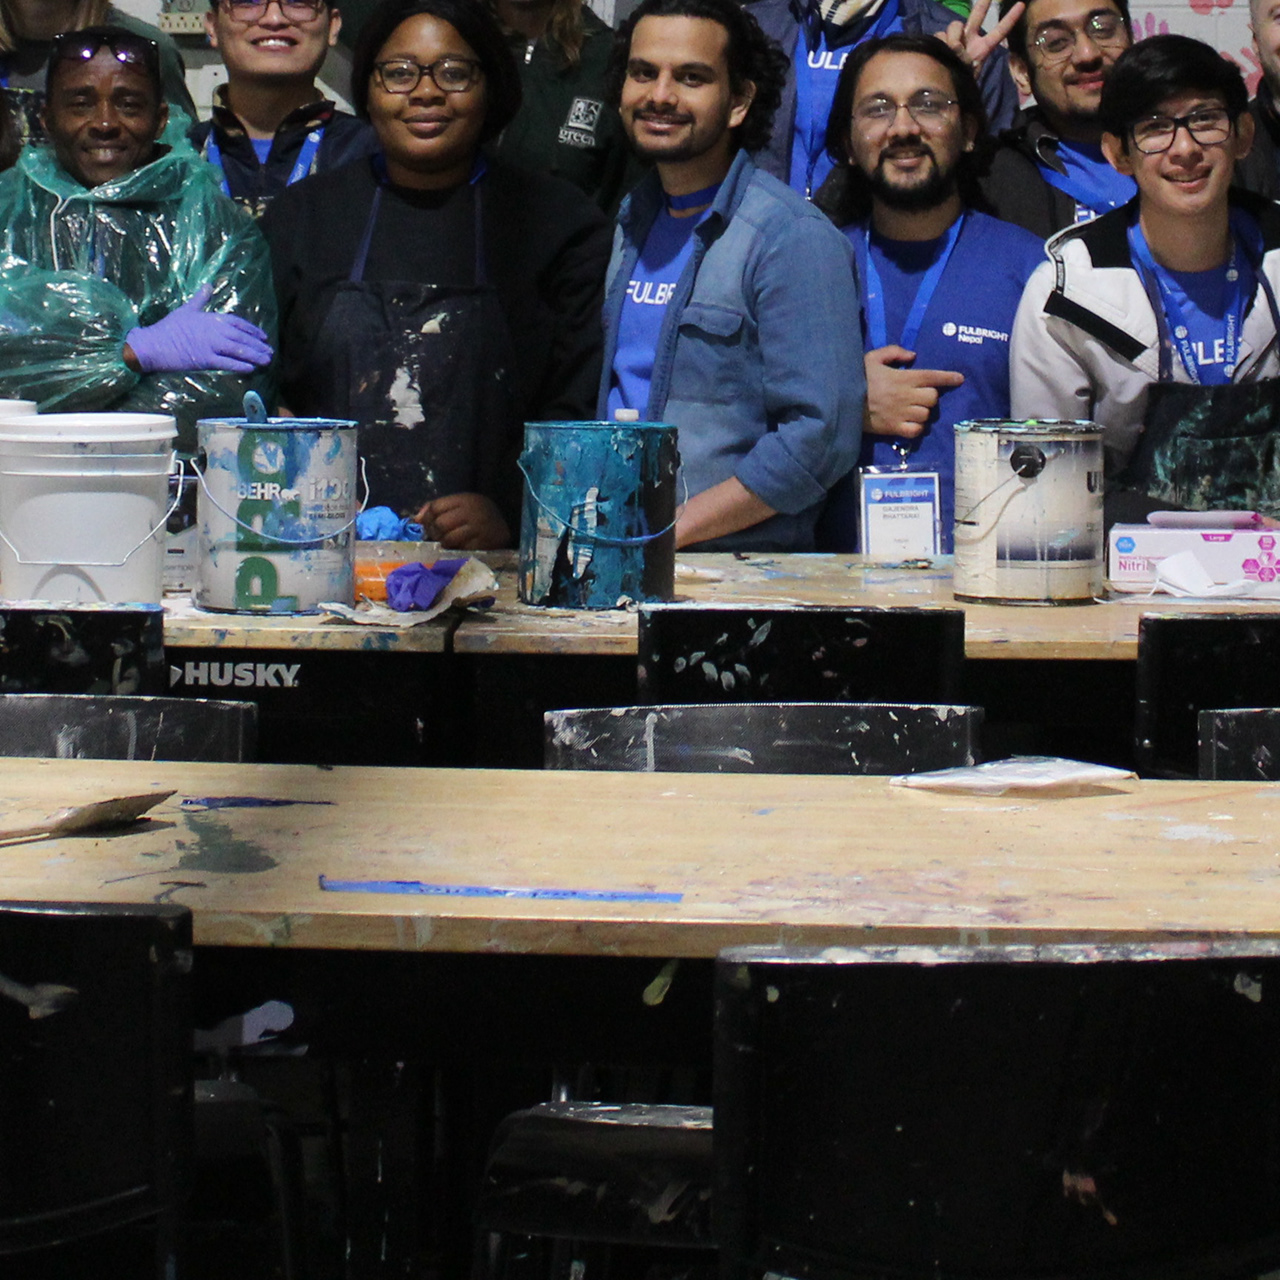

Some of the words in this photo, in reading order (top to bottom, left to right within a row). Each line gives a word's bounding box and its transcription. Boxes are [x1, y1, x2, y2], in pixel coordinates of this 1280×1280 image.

[957, 334, 983, 345] Nepal
[959, 325, 1009, 342] FULBRIGHT
[237, 482, 281, 500] BEHR
[1118, 560, 1151, 571] Nitril
[185, 662, 300, 687] HUSKY
